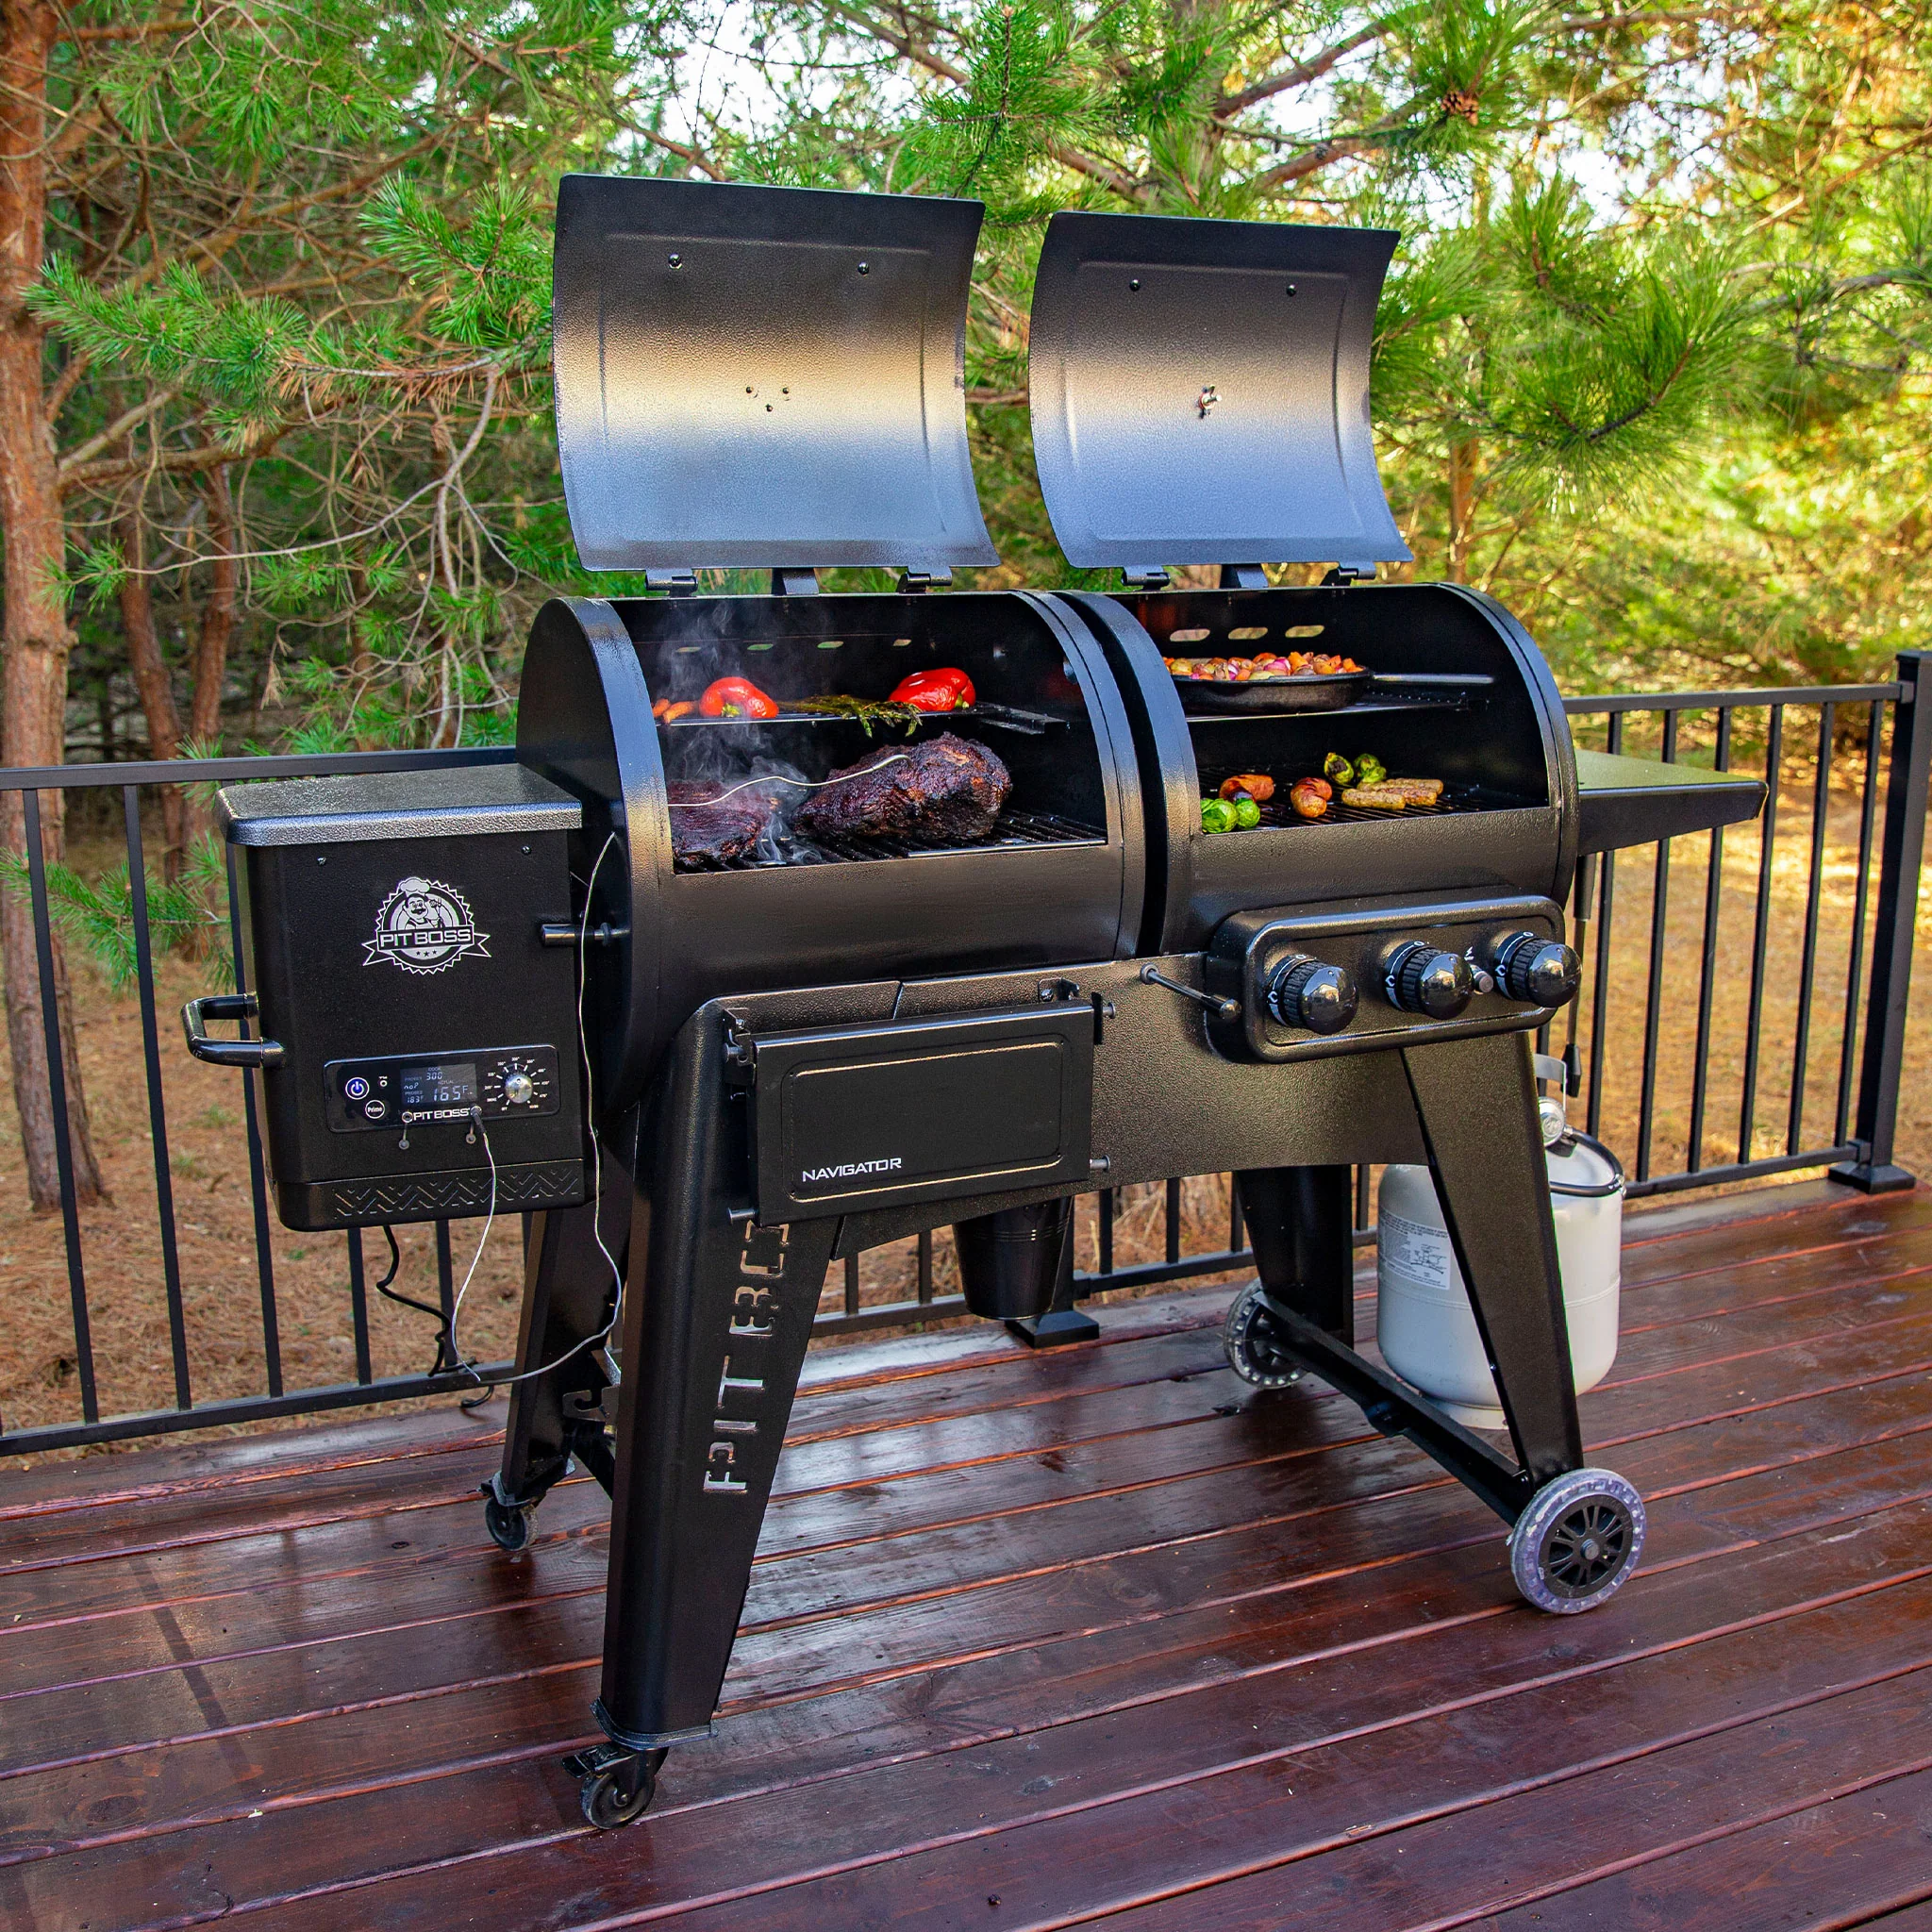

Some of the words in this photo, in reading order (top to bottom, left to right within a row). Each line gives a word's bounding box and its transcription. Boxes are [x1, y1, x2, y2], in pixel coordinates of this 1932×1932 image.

[379, 932, 413, 947] PIT
[414, 928, 471, 944] BOSS
[426, 1072, 443, 1081] 300
[413, 1110, 434, 1121] PIT
[434, 1108, 469, 1119] BOSS
[802, 1158, 902, 1182] NAVIGATOR
[728, 1219, 790, 1338] BO
[703, 1355, 765, 1492] PIT
